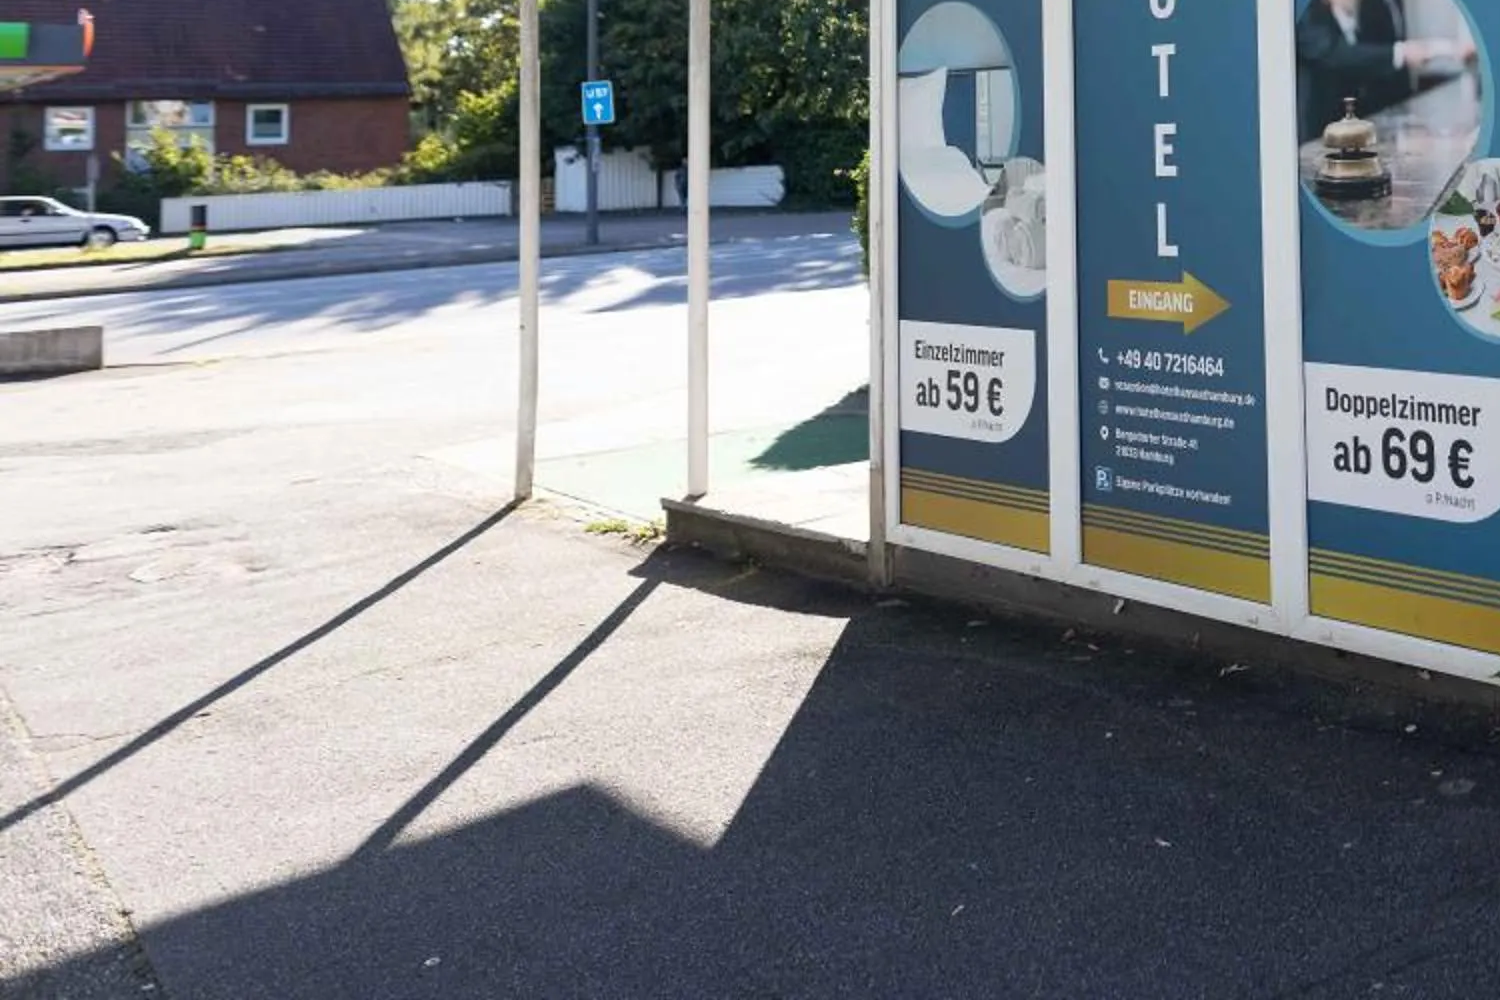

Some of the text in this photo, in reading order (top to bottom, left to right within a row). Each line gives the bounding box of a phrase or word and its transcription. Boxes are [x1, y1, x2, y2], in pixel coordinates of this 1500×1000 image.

[1128, 289, 1194, 313] EINGANG
[915, 339, 1005, 367] Einzelzimmer
[1116, 349, 1225, 377] +49 40 7216464
[916, 369, 1005, 416] ab 59 €
[1325, 386, 1481, 427] Doppelzimmer
[1333, 427, 1475, 489] ab 69 €
